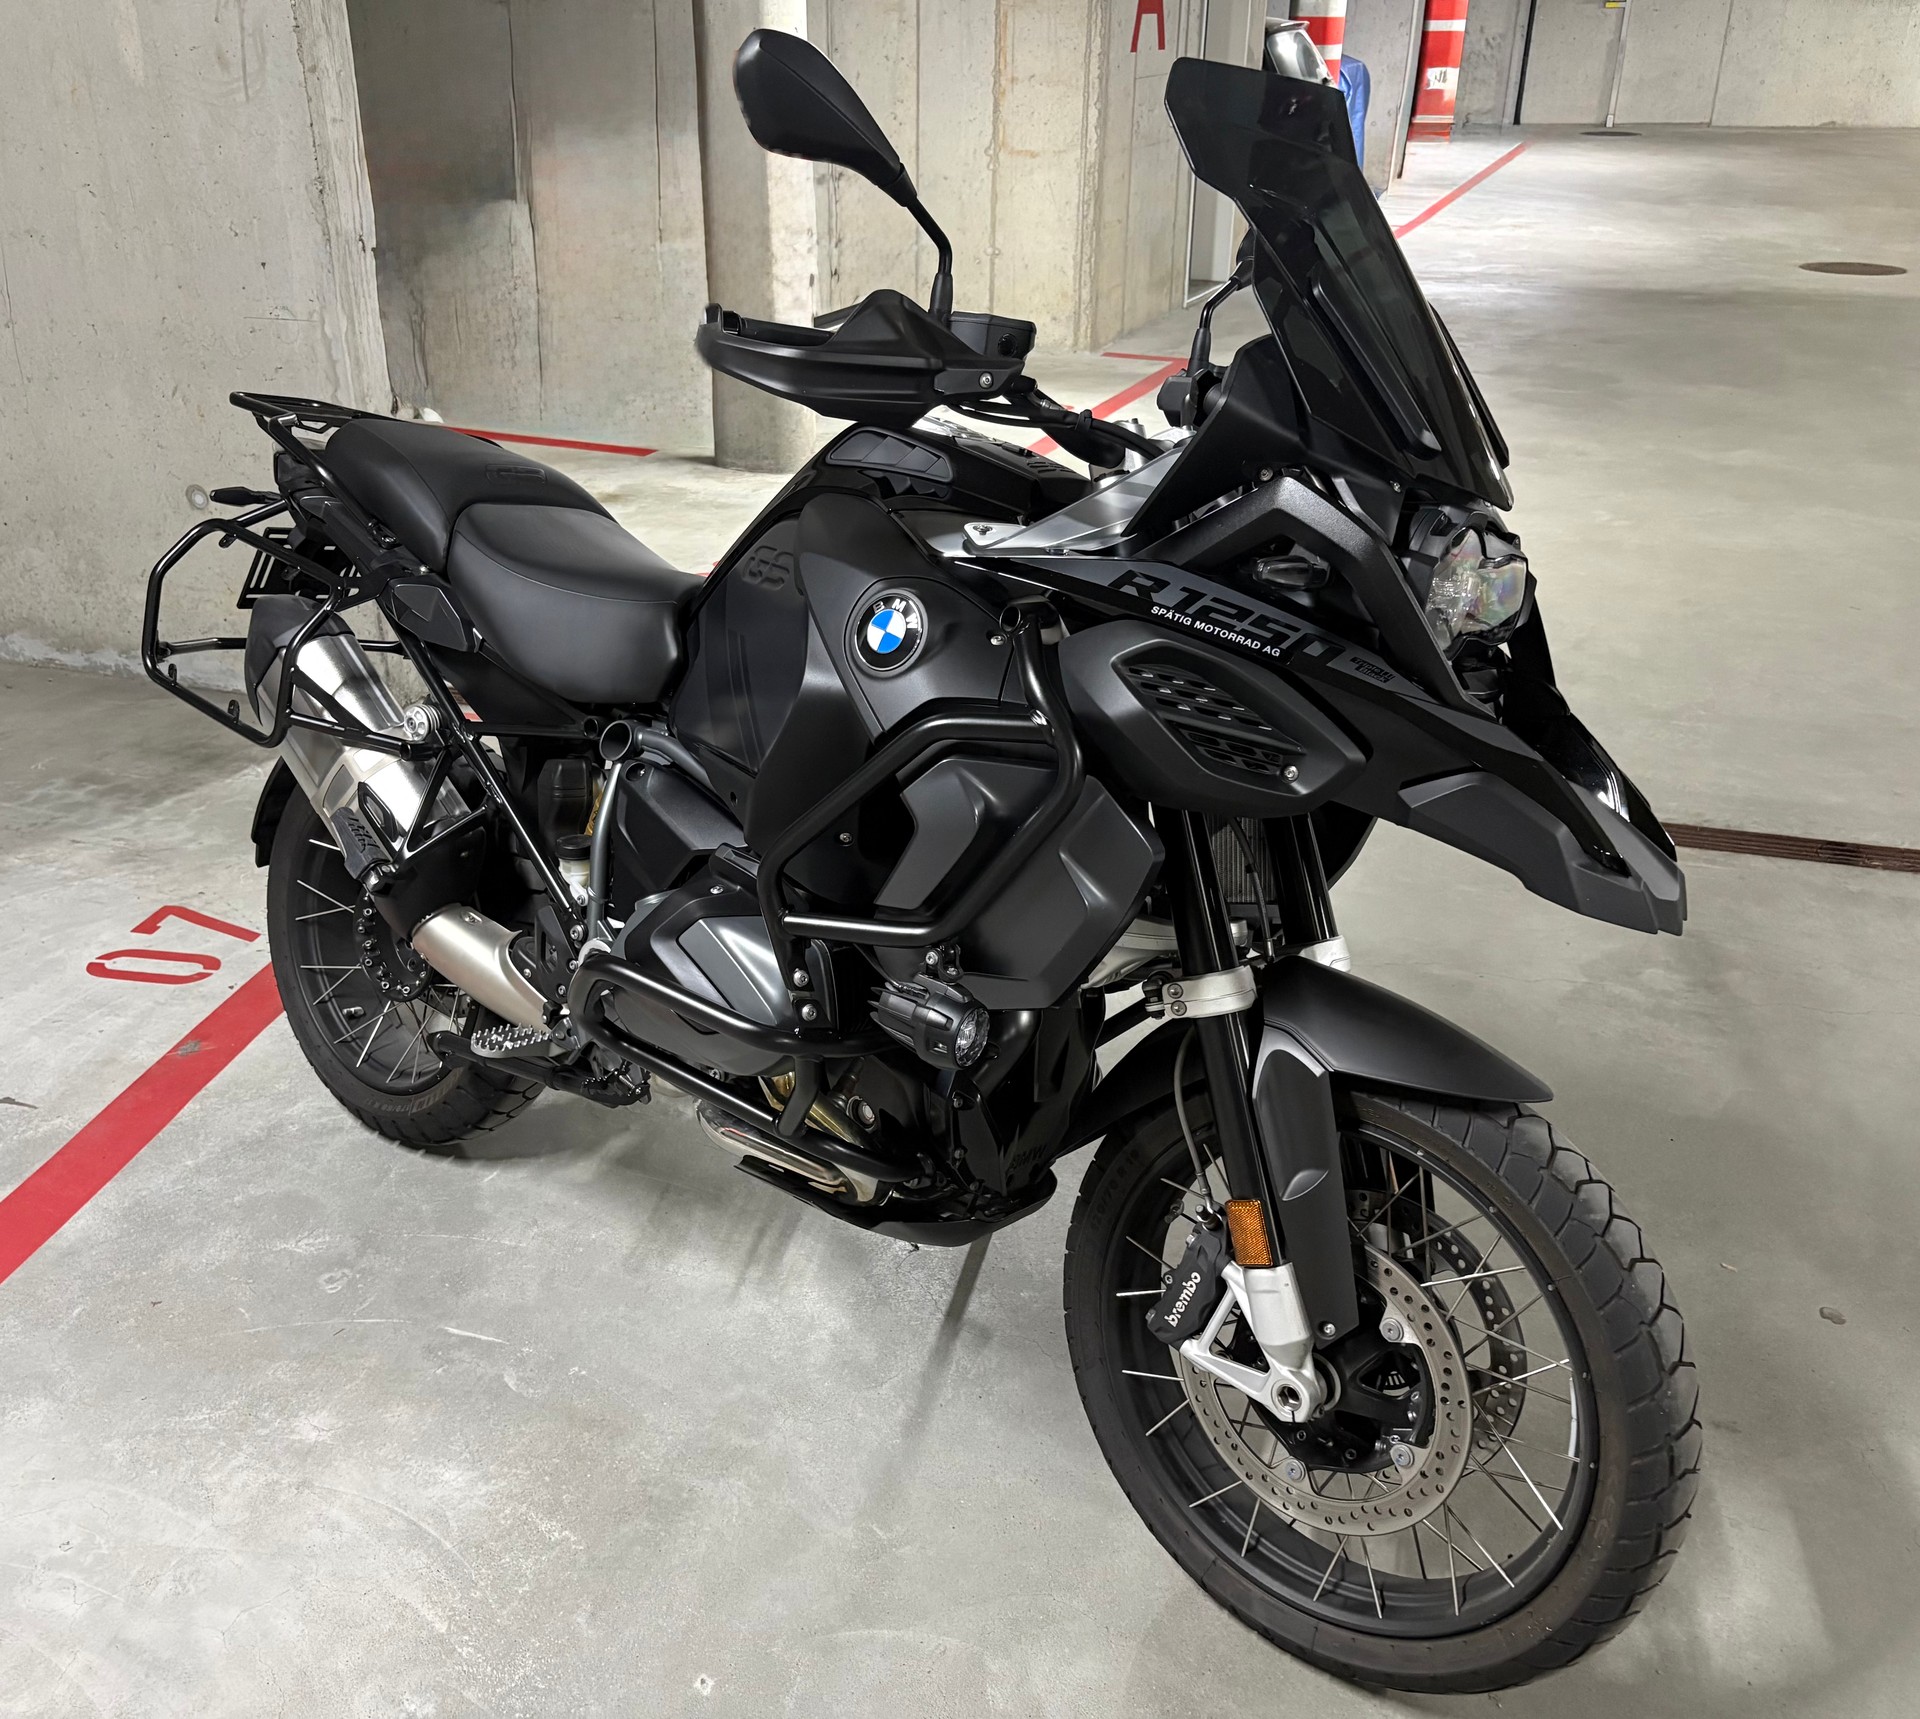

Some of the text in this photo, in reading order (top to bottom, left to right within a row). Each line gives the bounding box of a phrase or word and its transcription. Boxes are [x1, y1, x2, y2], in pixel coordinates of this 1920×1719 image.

[873, 598, 919, 629] BMW
[1150, 605, 1281, 658] SPÄTIG MOTORRAD AG
[1164, 1271, 1201, 1328] brembo
